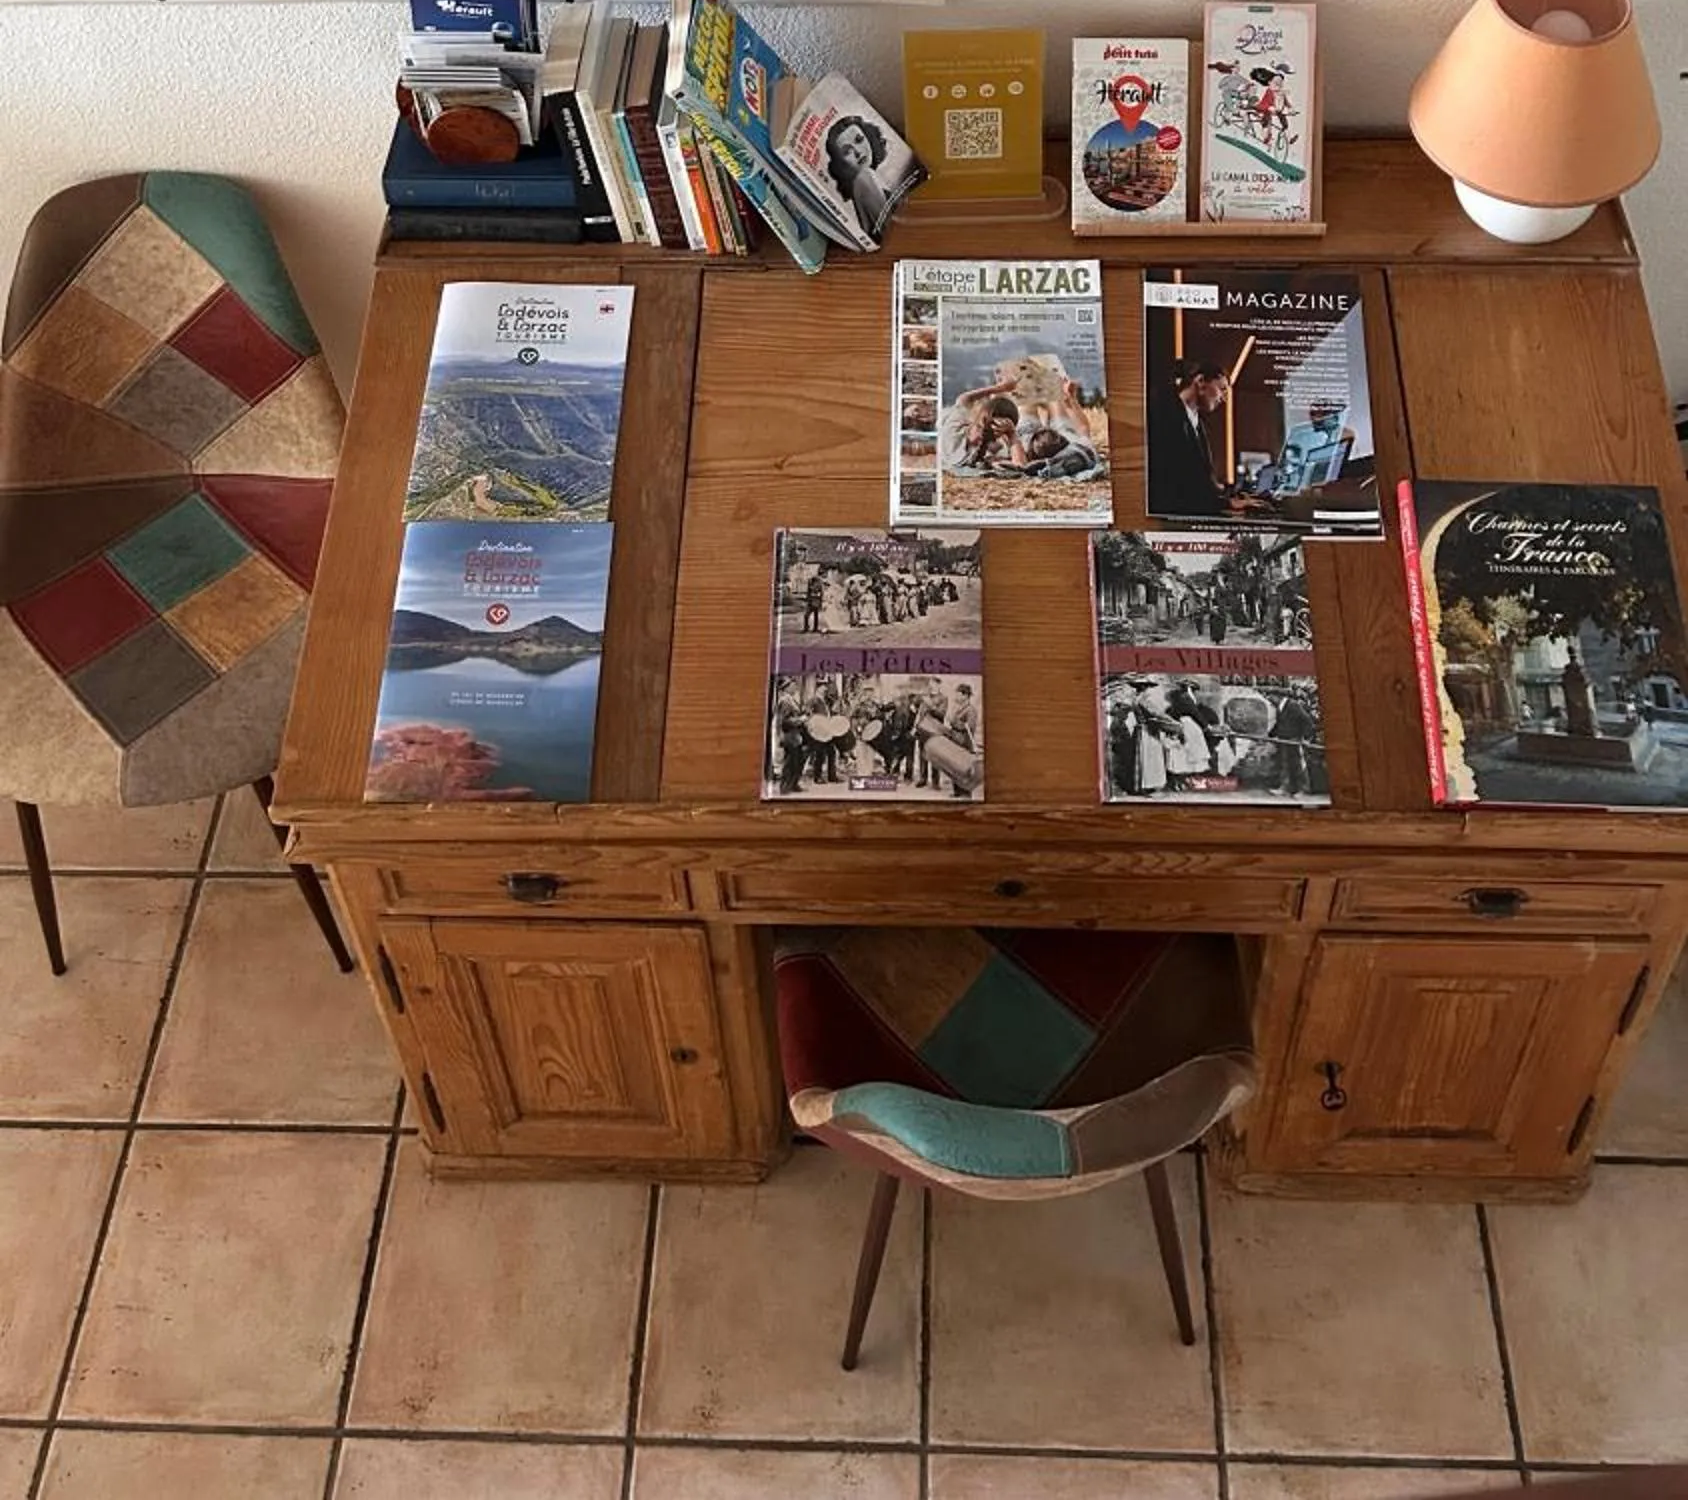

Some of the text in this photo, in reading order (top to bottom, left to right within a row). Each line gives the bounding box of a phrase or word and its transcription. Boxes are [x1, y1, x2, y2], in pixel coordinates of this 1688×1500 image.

[913, 266, 976, 283] L'étape
[979, 267, 1091, 294] LARZAC
[1226, 291, 1350, 312] MAGAZINE
[1465, 510, 1628, 535] Charmes et secrets
[1494, 532, 1611, 574] France
[1545, 534, 1565, 548] de
[801, 650, 953, 674] Les Fêtes
[1174, 648, 1279, 673] Villages
